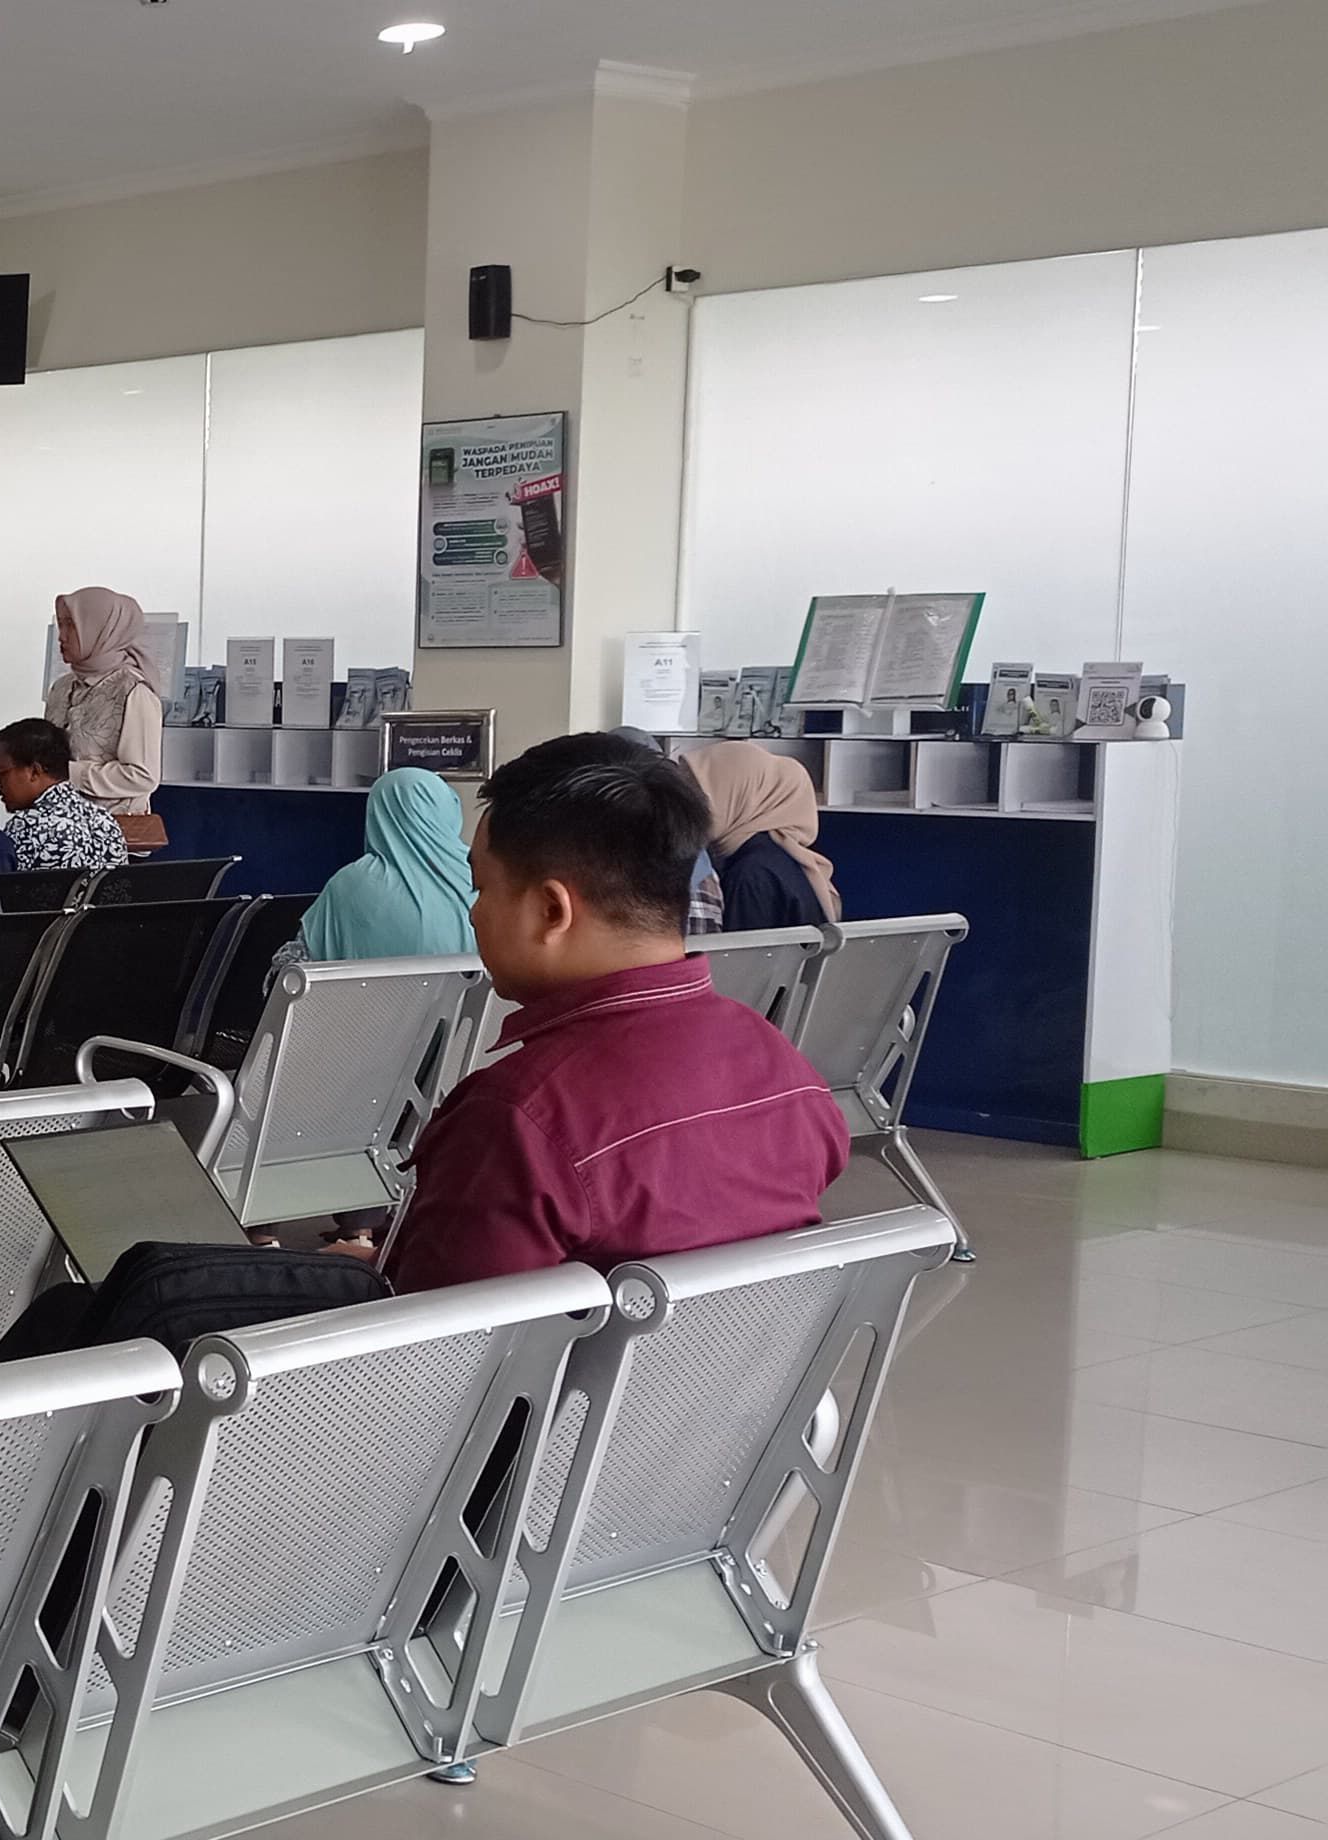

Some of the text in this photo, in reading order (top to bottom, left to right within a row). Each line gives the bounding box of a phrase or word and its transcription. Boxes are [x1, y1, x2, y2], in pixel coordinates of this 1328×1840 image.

[462, 449, 553, 467] JANGAN MUDAH
[463, 444, 506, 456] WASPADA
[475, 462, 541, 478] TERPEDAYA
[524, 477, 560, 497] HOAX!
[440, 735, 464, 744] Berkas
[466, 736, 472, 744] &
